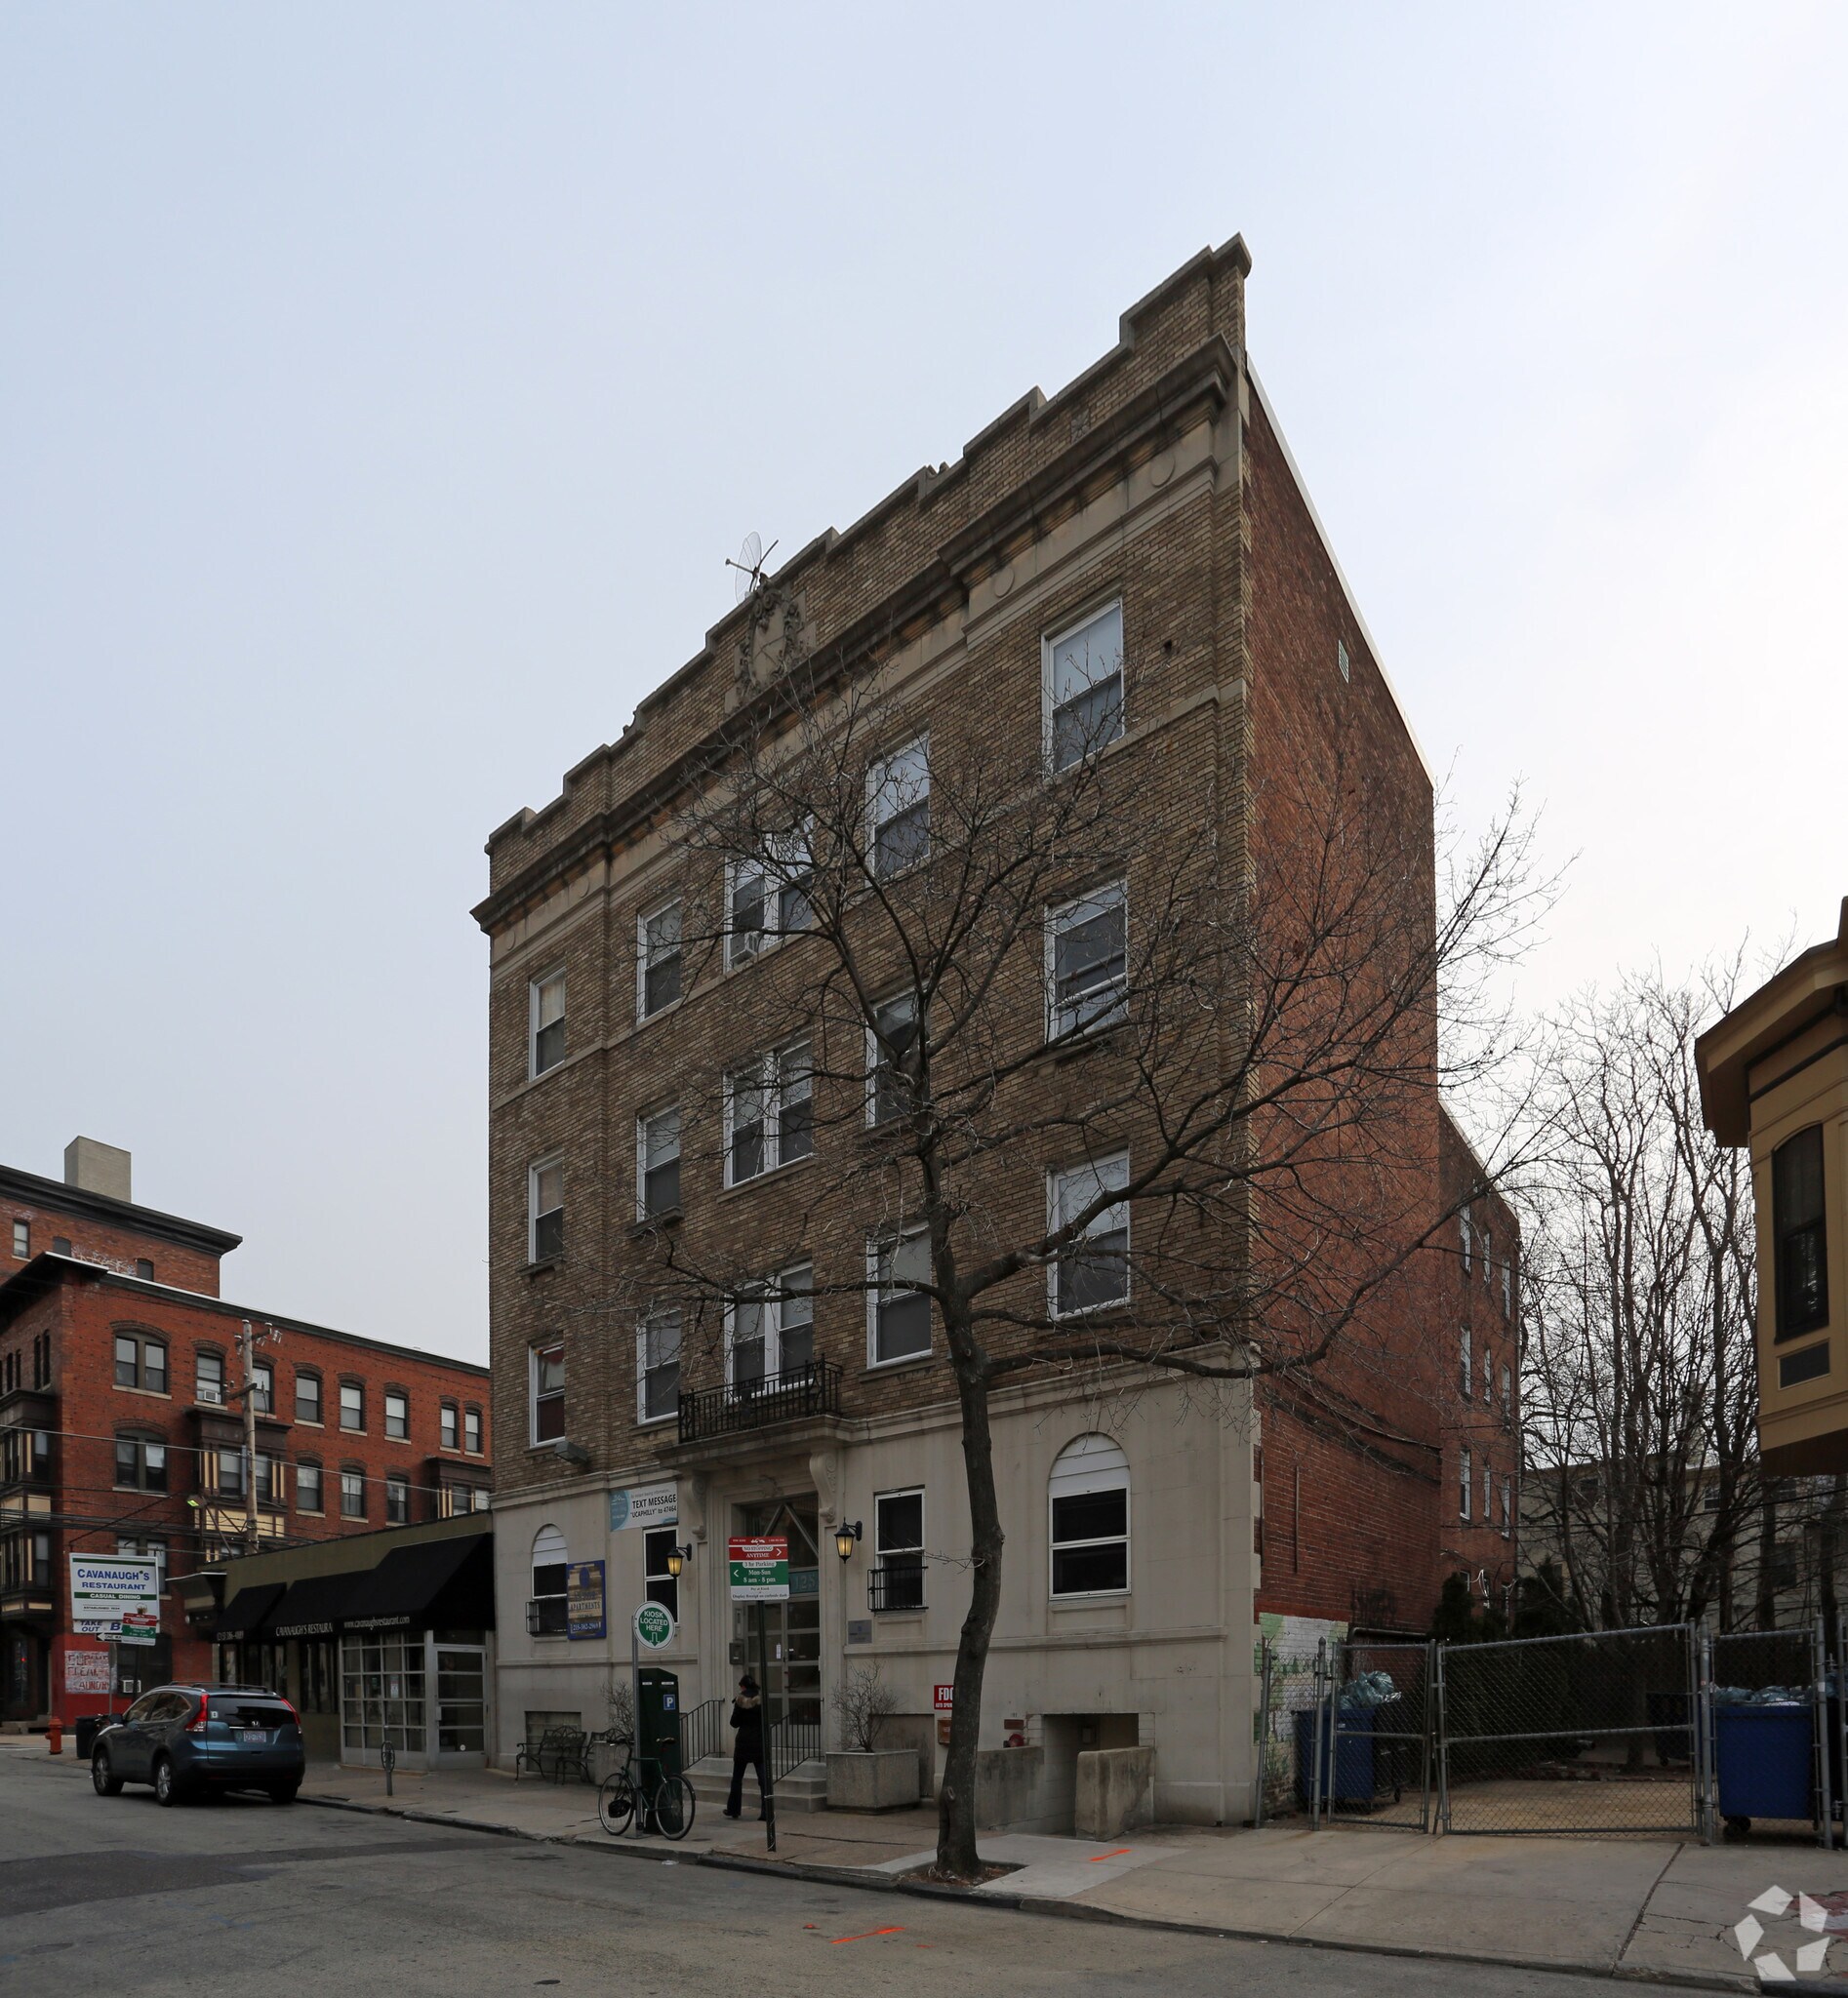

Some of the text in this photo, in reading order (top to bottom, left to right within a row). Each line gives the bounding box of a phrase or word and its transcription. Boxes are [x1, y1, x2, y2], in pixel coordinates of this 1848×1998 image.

[632, 1494, 676, 1509] TEXT MESSAGE
[77, 1569, 150, 1580] CAVANAUGH'S
[82, 1581, 146, 1590] RESTAURANT
[570, 1601, 601, 1611] APARTMENTS
[640, 1618, 668, 1626] LOCATED
[275, 1622, 334, 1637] CAVANAUGH'S RESTAURA
[666, 1697, 673, 1707] P
